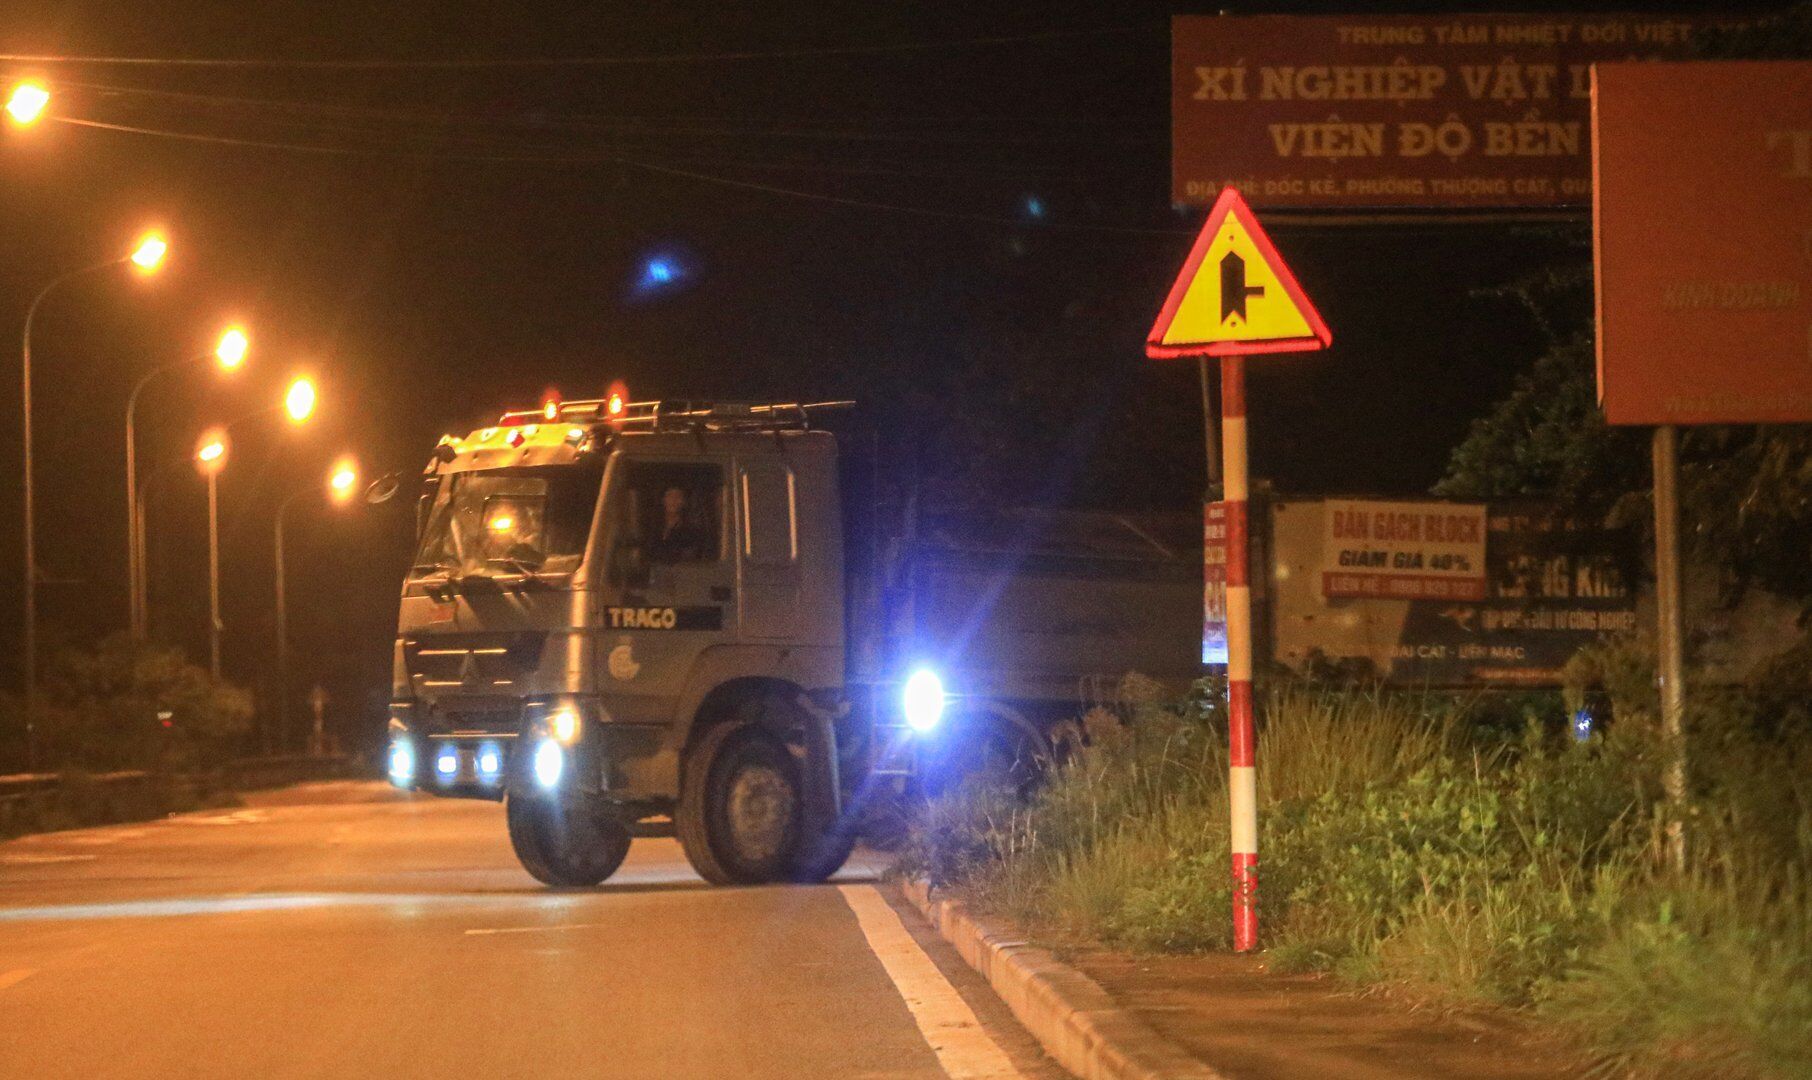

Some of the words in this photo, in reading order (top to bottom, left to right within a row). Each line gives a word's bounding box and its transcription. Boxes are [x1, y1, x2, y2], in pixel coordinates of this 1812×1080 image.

[1337, 25, 1425, 44] TRUNG
[1433, 20, 1489, 44] TÂM
[1496, 20, 1572, 46] NHIỆT
[1634, 20, 1692, 46] VIỆT
[1193, 57, 1247, 100] XÍ
[1260, 55, 1447, 107] NGHIỆP
[1461, 56, 1558, 106] VẬT
[1268, 113, 1386, 163] VIỆN
[1399, 112, 1472, 163] ĐỘ
[1483, 107, 1582, 156] BỀN
[1333, 505, 1369, 539] BÁN
[1425, 514, 1481, 543] BLOCK
[1430, 553, 1472, 572] 40%
[608, 607, 677, 629] TRAGO
